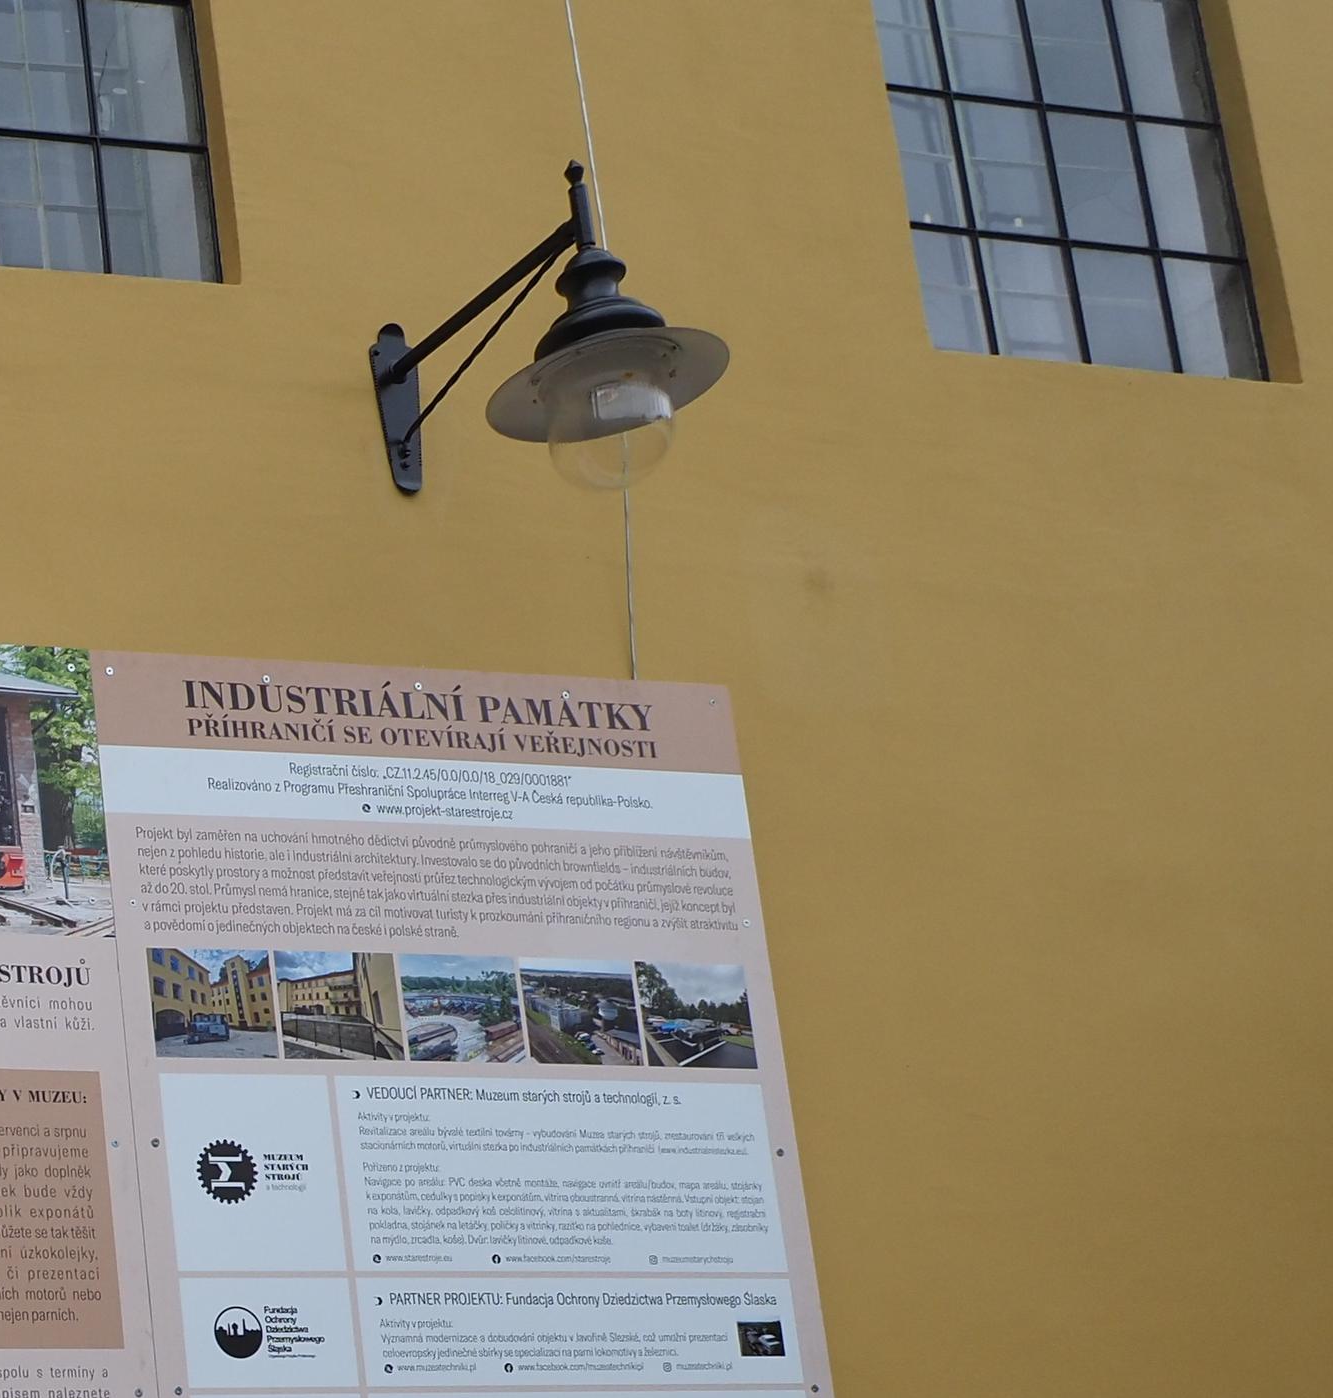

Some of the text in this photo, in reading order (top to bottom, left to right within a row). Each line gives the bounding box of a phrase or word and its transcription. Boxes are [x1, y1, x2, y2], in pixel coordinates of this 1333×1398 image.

[182, 680, 465, 721] INDUSTRIÁLNÍ
[187, 718, 656, 758] PŘÍHRANIČÍ SE OTEVÍRAJÍ VEŘEJNOSTI
[376, 804, 512, 822] www.projekt-starestroje.cz
[13, 1090, 21, 1100] V
[28, 1090, 86, 1103] MUZEU:
[420, 1087, 473, 1100] PARTNER:
[475, 1088, 519, 1101] Muzeum
[522, 1089, 559, 1104] starých
[562, 1090, 591, 1105] strojů
[389, 1292, 441, 1305] PARTNER
[444, 1292, 503, 1305] PROJEKTU:
[505, 1292, 553, 1308] Fundacja
[556, 1292, 599, 1307] Ochrony
